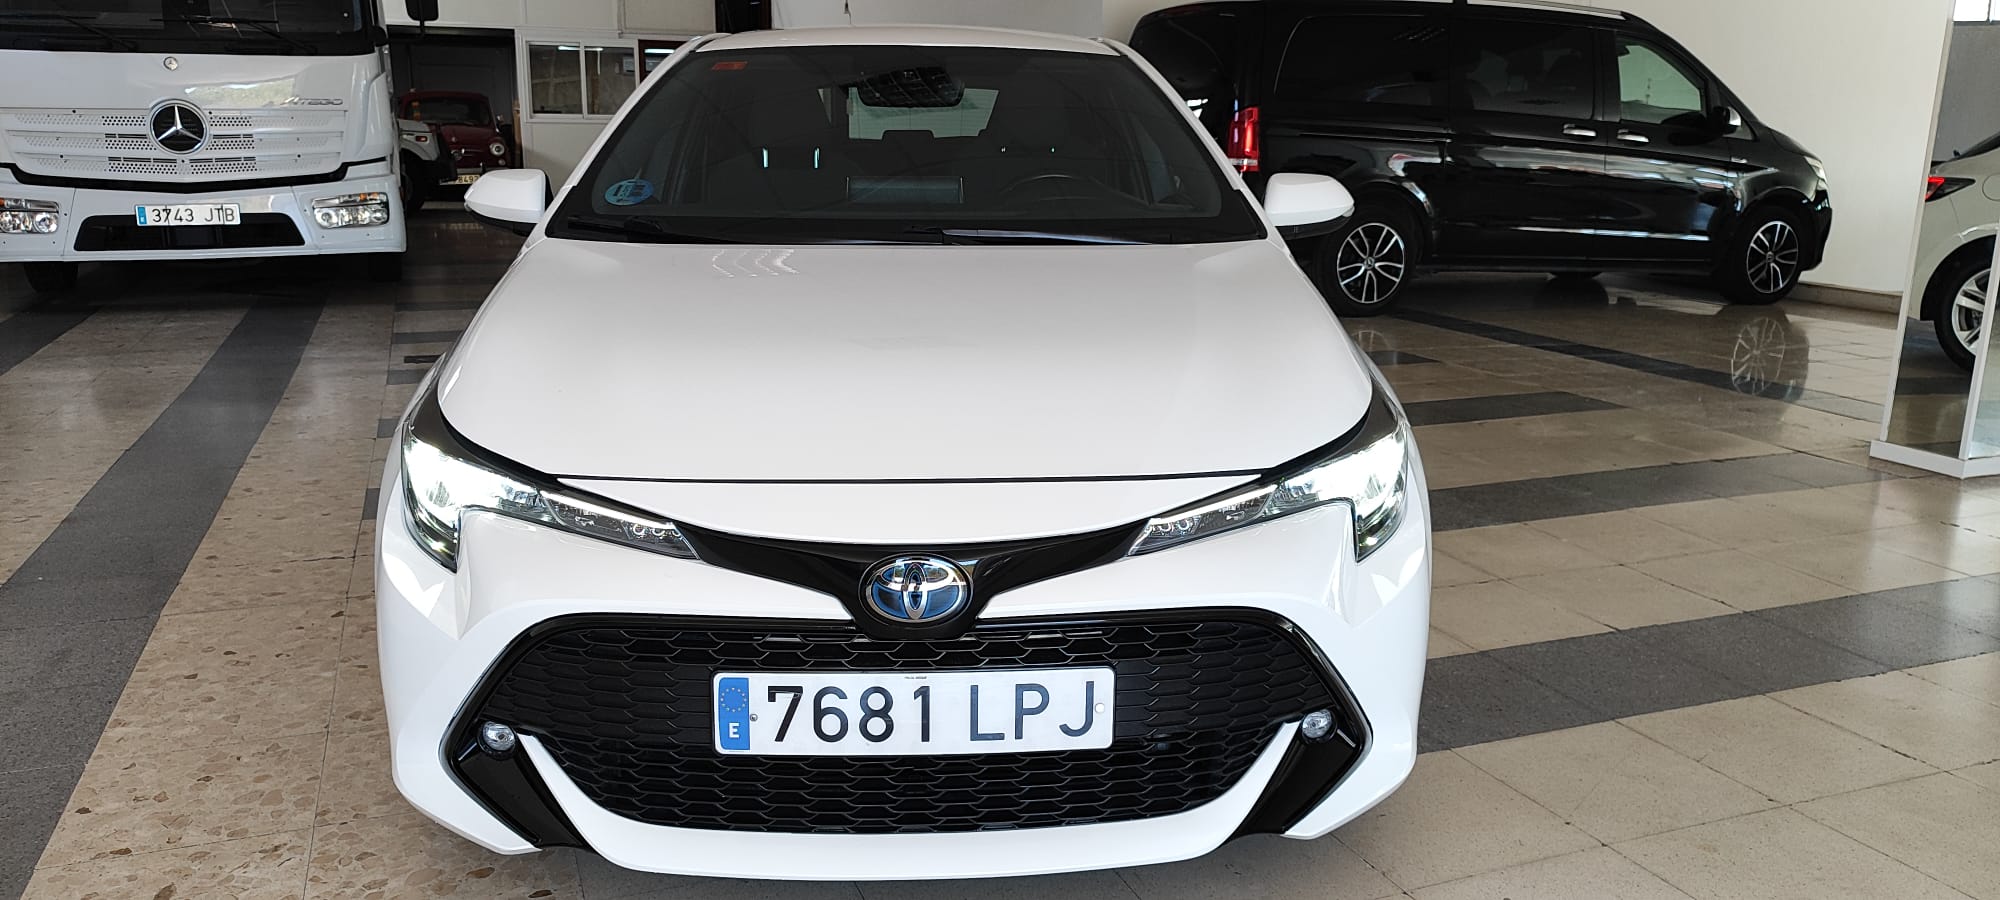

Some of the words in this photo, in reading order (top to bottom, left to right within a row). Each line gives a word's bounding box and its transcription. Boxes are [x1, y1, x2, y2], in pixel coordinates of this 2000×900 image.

[151, 208, 194, 223] 3743
[204, 207, 235, 222] JTB
[767, 685, 931, 743] 7681
[969, 680, 1095, 742] LPJ
[728, 722, 740, 739] E
